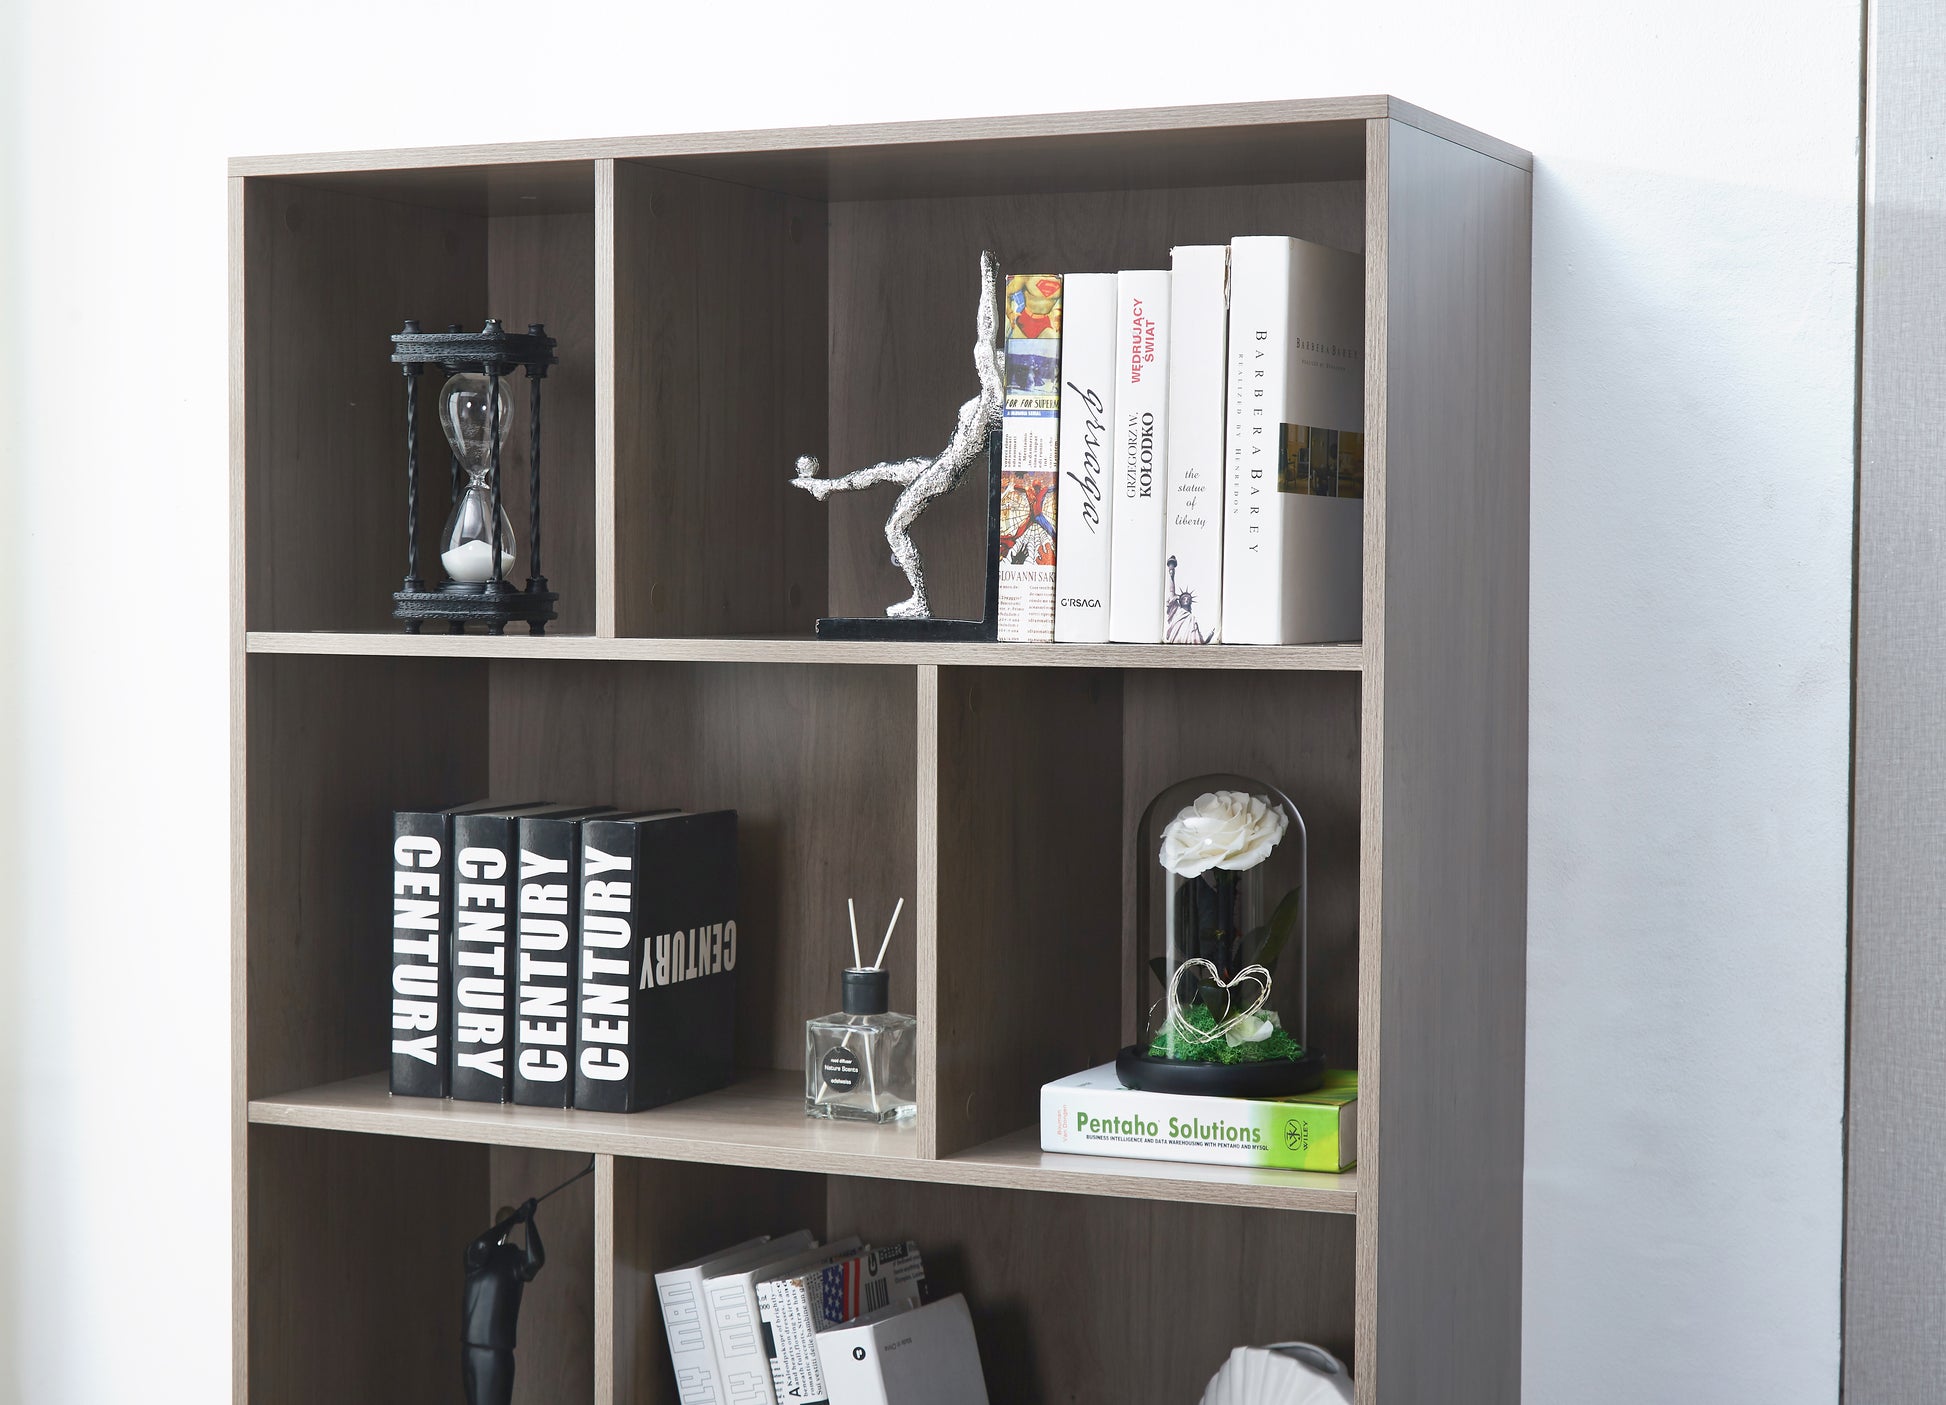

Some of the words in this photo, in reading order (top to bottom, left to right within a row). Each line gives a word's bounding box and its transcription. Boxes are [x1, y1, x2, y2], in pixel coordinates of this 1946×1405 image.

[1132, 298, 1144, 383] WĘDRUJĄCY
[1142, 320, 1155, 362] ŚWIAT
[1126, 429, 1138, 498] GRZEGORZ
[1140, 412, 1154, 498] KOŁODKO
[1185, 468, 1200, 480] the
[1178, 484, 1206, 493] statue
[1186, 497, 1197, 510] of
[1175, 515, 1207, 529] liberty
[392, 836, 441, 1065] CENTURY
[457, 847, 507, 1078] CENTURY
[518, 848, 568, 1082] CENTURY
[580, 845, 632, 1081] CENTURY
[639, 920, 736, 990] CENTURY
[1077, 1112, 1158, 1137] Pentaho
[1168, 1117, 1261, 1143] Solutions
[1168, 1139, 1204, 1147] WAREHOUSING
[803, 1306, 812, 1337] bambine
[678, 1367, 717, 1405] LY
